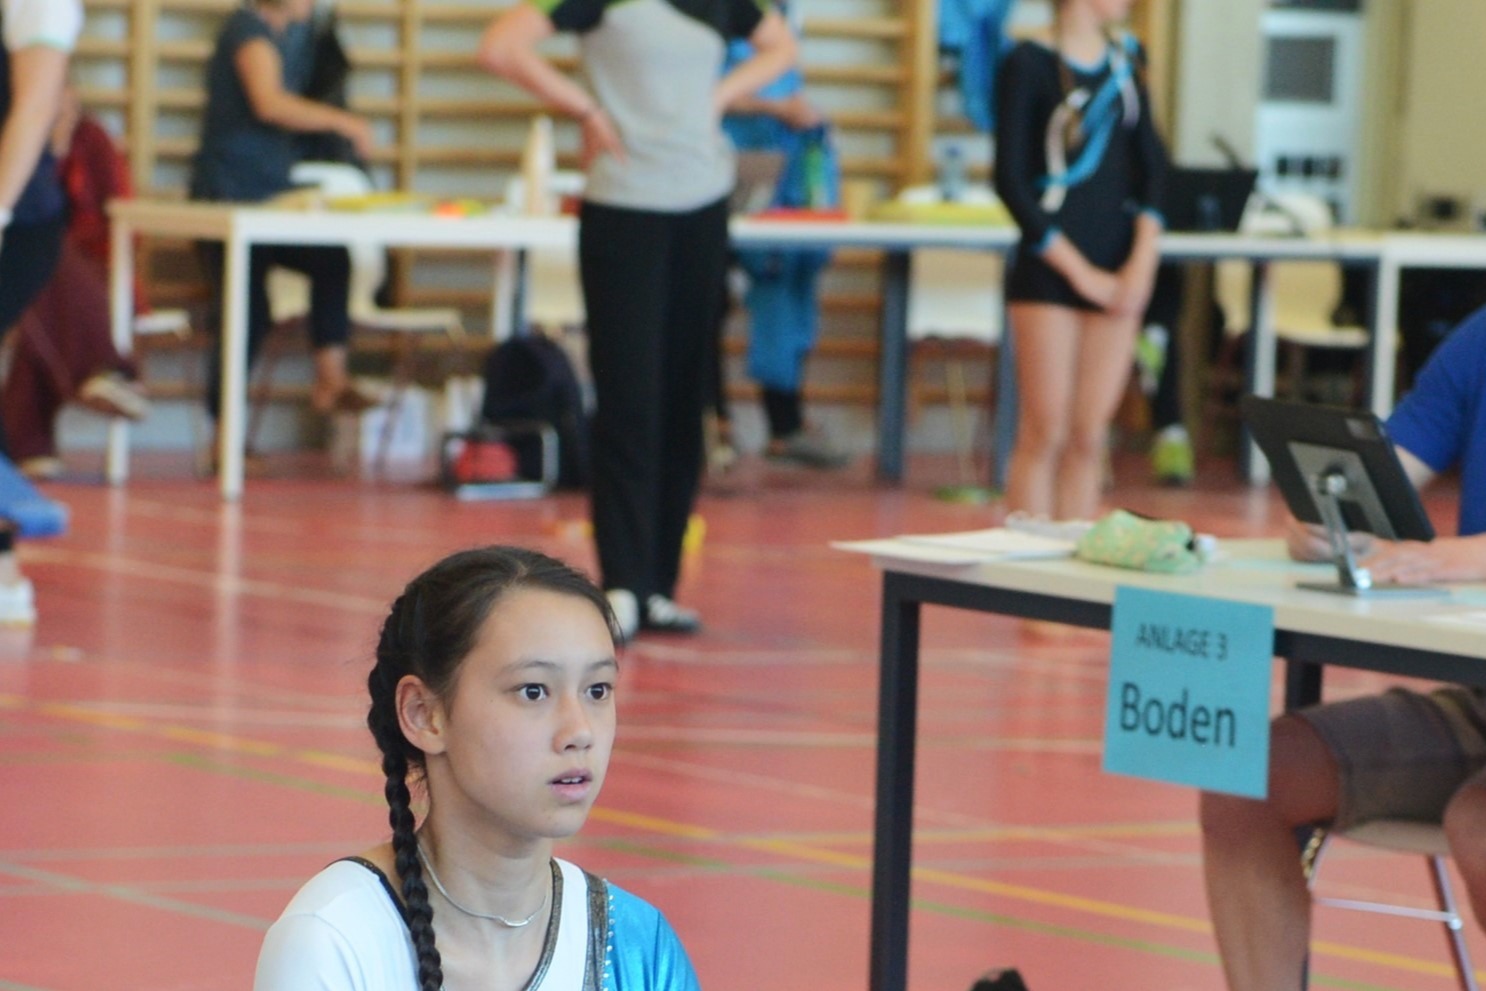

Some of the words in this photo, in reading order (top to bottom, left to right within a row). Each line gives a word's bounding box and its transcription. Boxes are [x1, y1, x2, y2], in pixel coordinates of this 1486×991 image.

[1135, 622, 1209, 659] ANLAGE
[1216, 631, 1229, 661] 3
[1120, 681, 1236, 748] Boden
